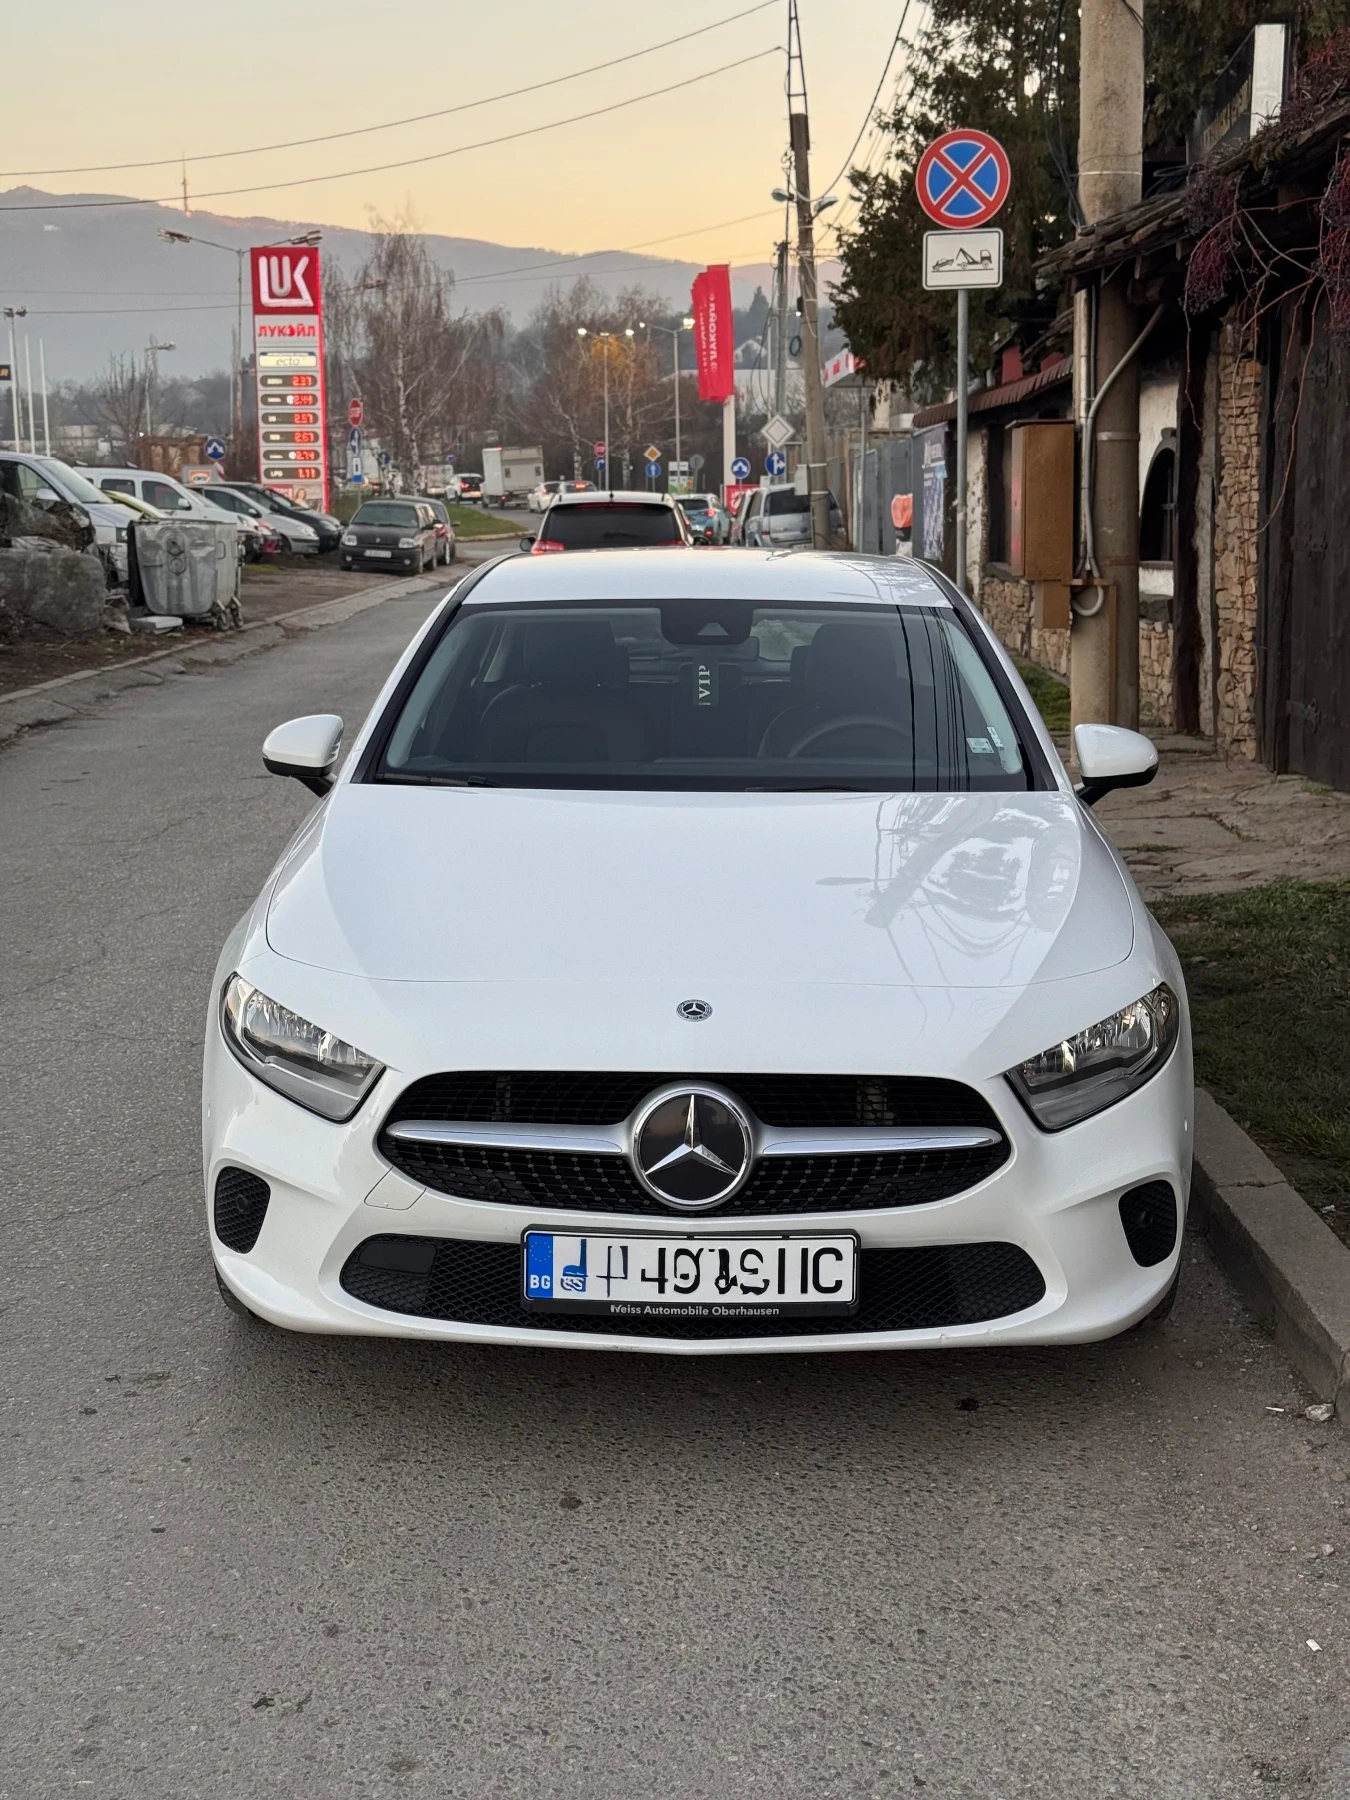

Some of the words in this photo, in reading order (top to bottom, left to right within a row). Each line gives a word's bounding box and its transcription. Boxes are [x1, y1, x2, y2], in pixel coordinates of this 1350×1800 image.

[258, 323, 315, 337] ЛУКОЙЛ
[276, 357, 300, 366] ecto
[698, 664, 711, 699] VIP
[529, 1274, 551, 1290] BG
[644, 1305, 709, 1316] Automobile
[711, 1306, 780, 1316] Oberhausen
